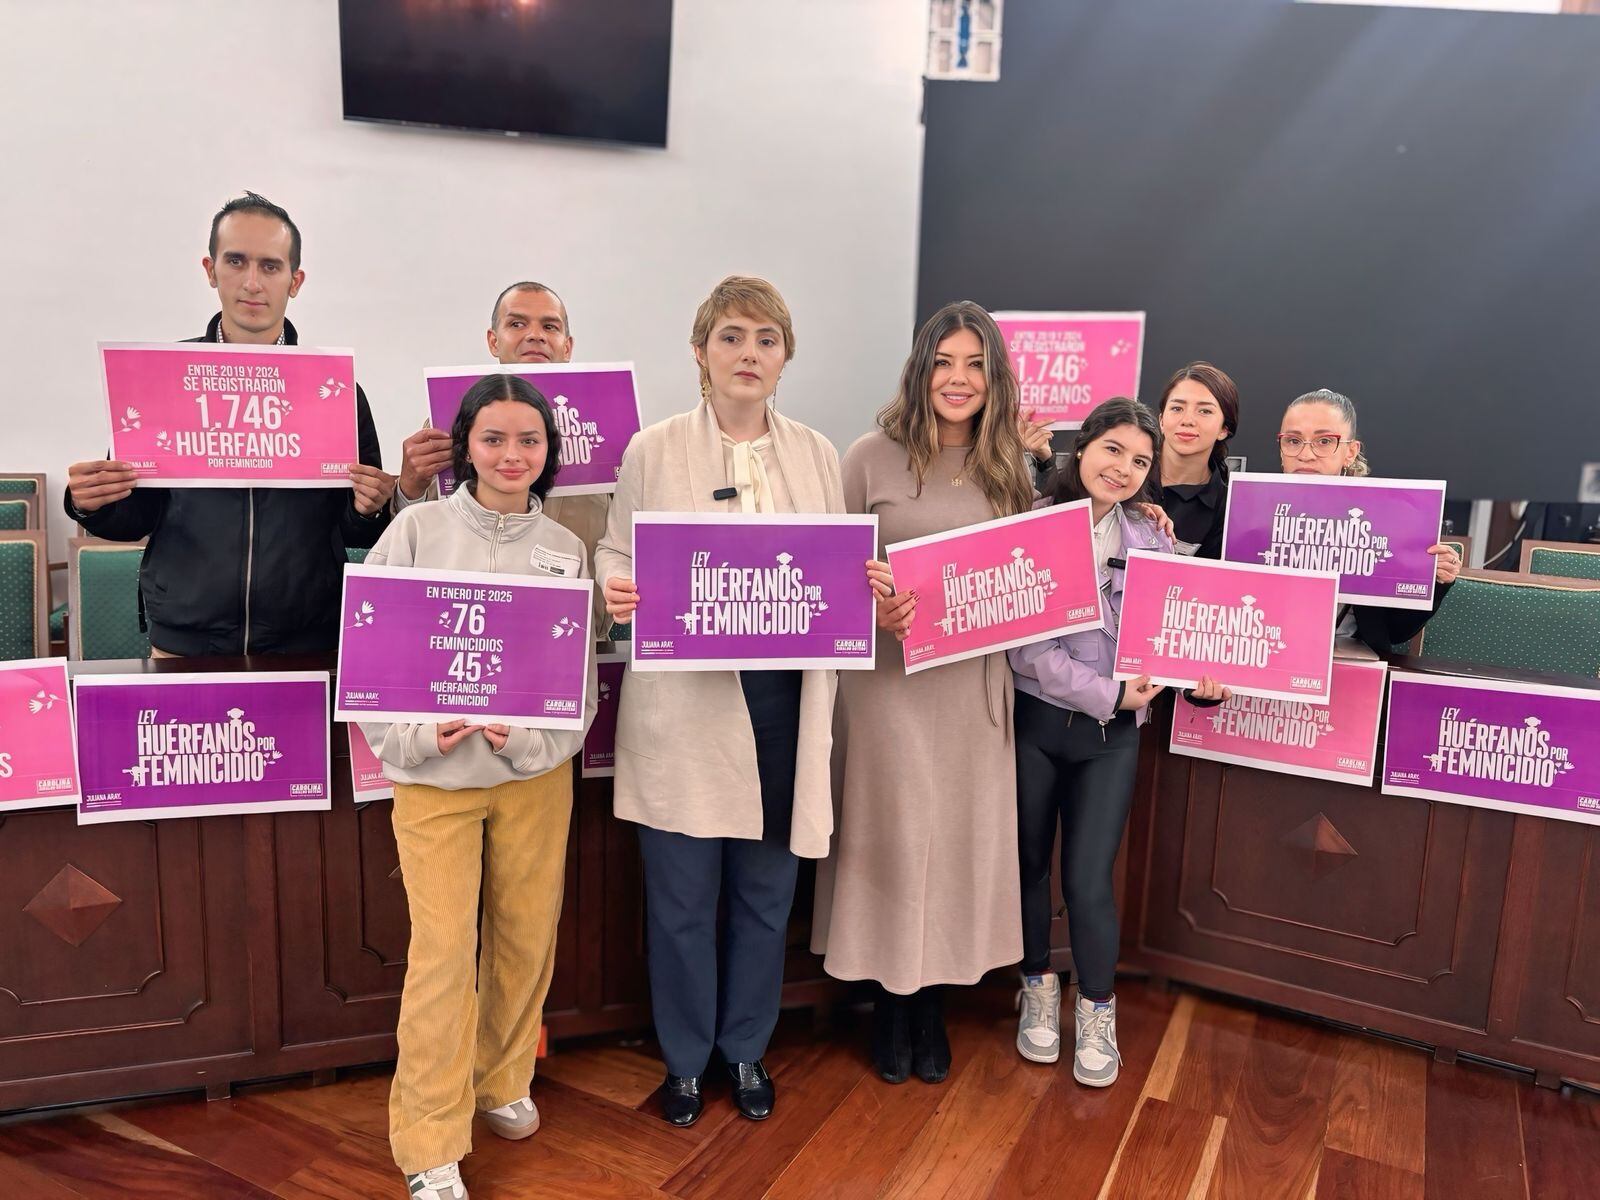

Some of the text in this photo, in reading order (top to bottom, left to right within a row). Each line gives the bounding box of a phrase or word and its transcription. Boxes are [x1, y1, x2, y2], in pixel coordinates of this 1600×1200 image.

[187, 364, 279, 378] ENTRE 2019 Y 2024
[1016, 354, 1079, 383] 1.746
[183, 377, 286, 393] SE REGISTRARON
[1020, 381, 1092, 405] ÉRFANOS
[195, 394, 282, 430] 1.746
[581, 422, 598, 436] POR
[176, 427, 301, 458] HUÉRFANOS
[208, 458, 273, 469] POR FEMINICIDIO
[1274, 503, 1292, 517] LEY
[1271, 512, 1388, 550] HUÉRFANOS POR
[691, 551, 711, 568] LEY
[942, 562, 958, 580] LEY
[1270, 543, 1376, 577] FEMINICIDIO
[426, 586, 513, 602] EN ENERO DE 2025
[691, 561, 822, 601] HUÉRFANOS POR
[942, 557, 1052, 608] HUÉRFANOS POR
[1165, 585, 1184, 600] LEY
[452, 603, 486, 636] 76
[690, 601, 810, 635] FEMINICIDIO
[946, 585, 1046, 636] FEMINICIDIO
[1162, 597, 1282, 640] HUÉRFANOS POR
[429, 635, 503, 653] FEMINICIDIOS
[1158, 627, 1269, 669] FEMINICIDIO
[448, 652, 482, 682] 45
[345, 691, 365, 700] JULIANA
[430, 680, 497, 695] HUÉRFANOS POR
[437, 694, 489, 707] FEMINICIDIO
[137, 709, 158, 725] LEY
[1313, 709, 1330, 724] POR
[1441, 706, 1461, 721] LEY
[137, 718, 276, 756] HUÉRFANOS POR
[1216, 708, 1318, 749] FEMINICIDIO
[1438, 718, 1569, 761] HUÉRFANOS POR
[138, 751, 264, 787] FEMINICIDIO
[1436, 746, 1555, 788] FEMINICIDIO
[1579, 797, 1600, 805] CAROL
